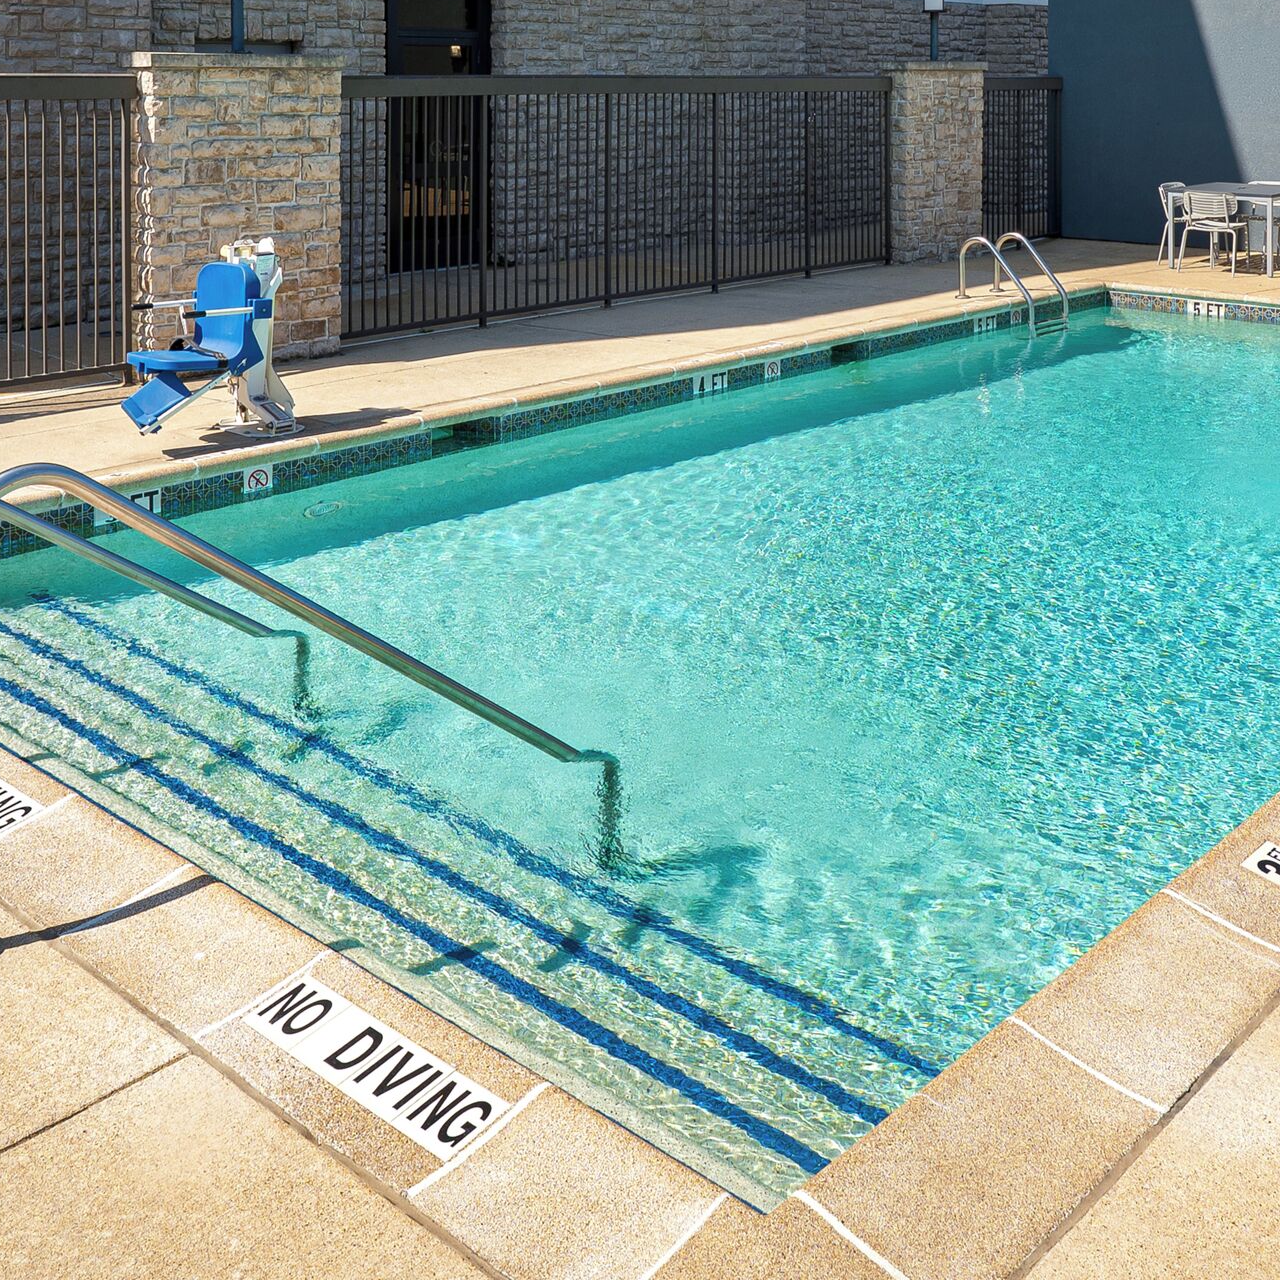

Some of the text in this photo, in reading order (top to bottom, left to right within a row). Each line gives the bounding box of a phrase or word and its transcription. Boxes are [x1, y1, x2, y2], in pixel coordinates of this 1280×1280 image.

[1193, 301, 1201, 317] 5
[698, 371, 727, 394] 4 FT
[256, 981, 495, 1150] NO DIVING
